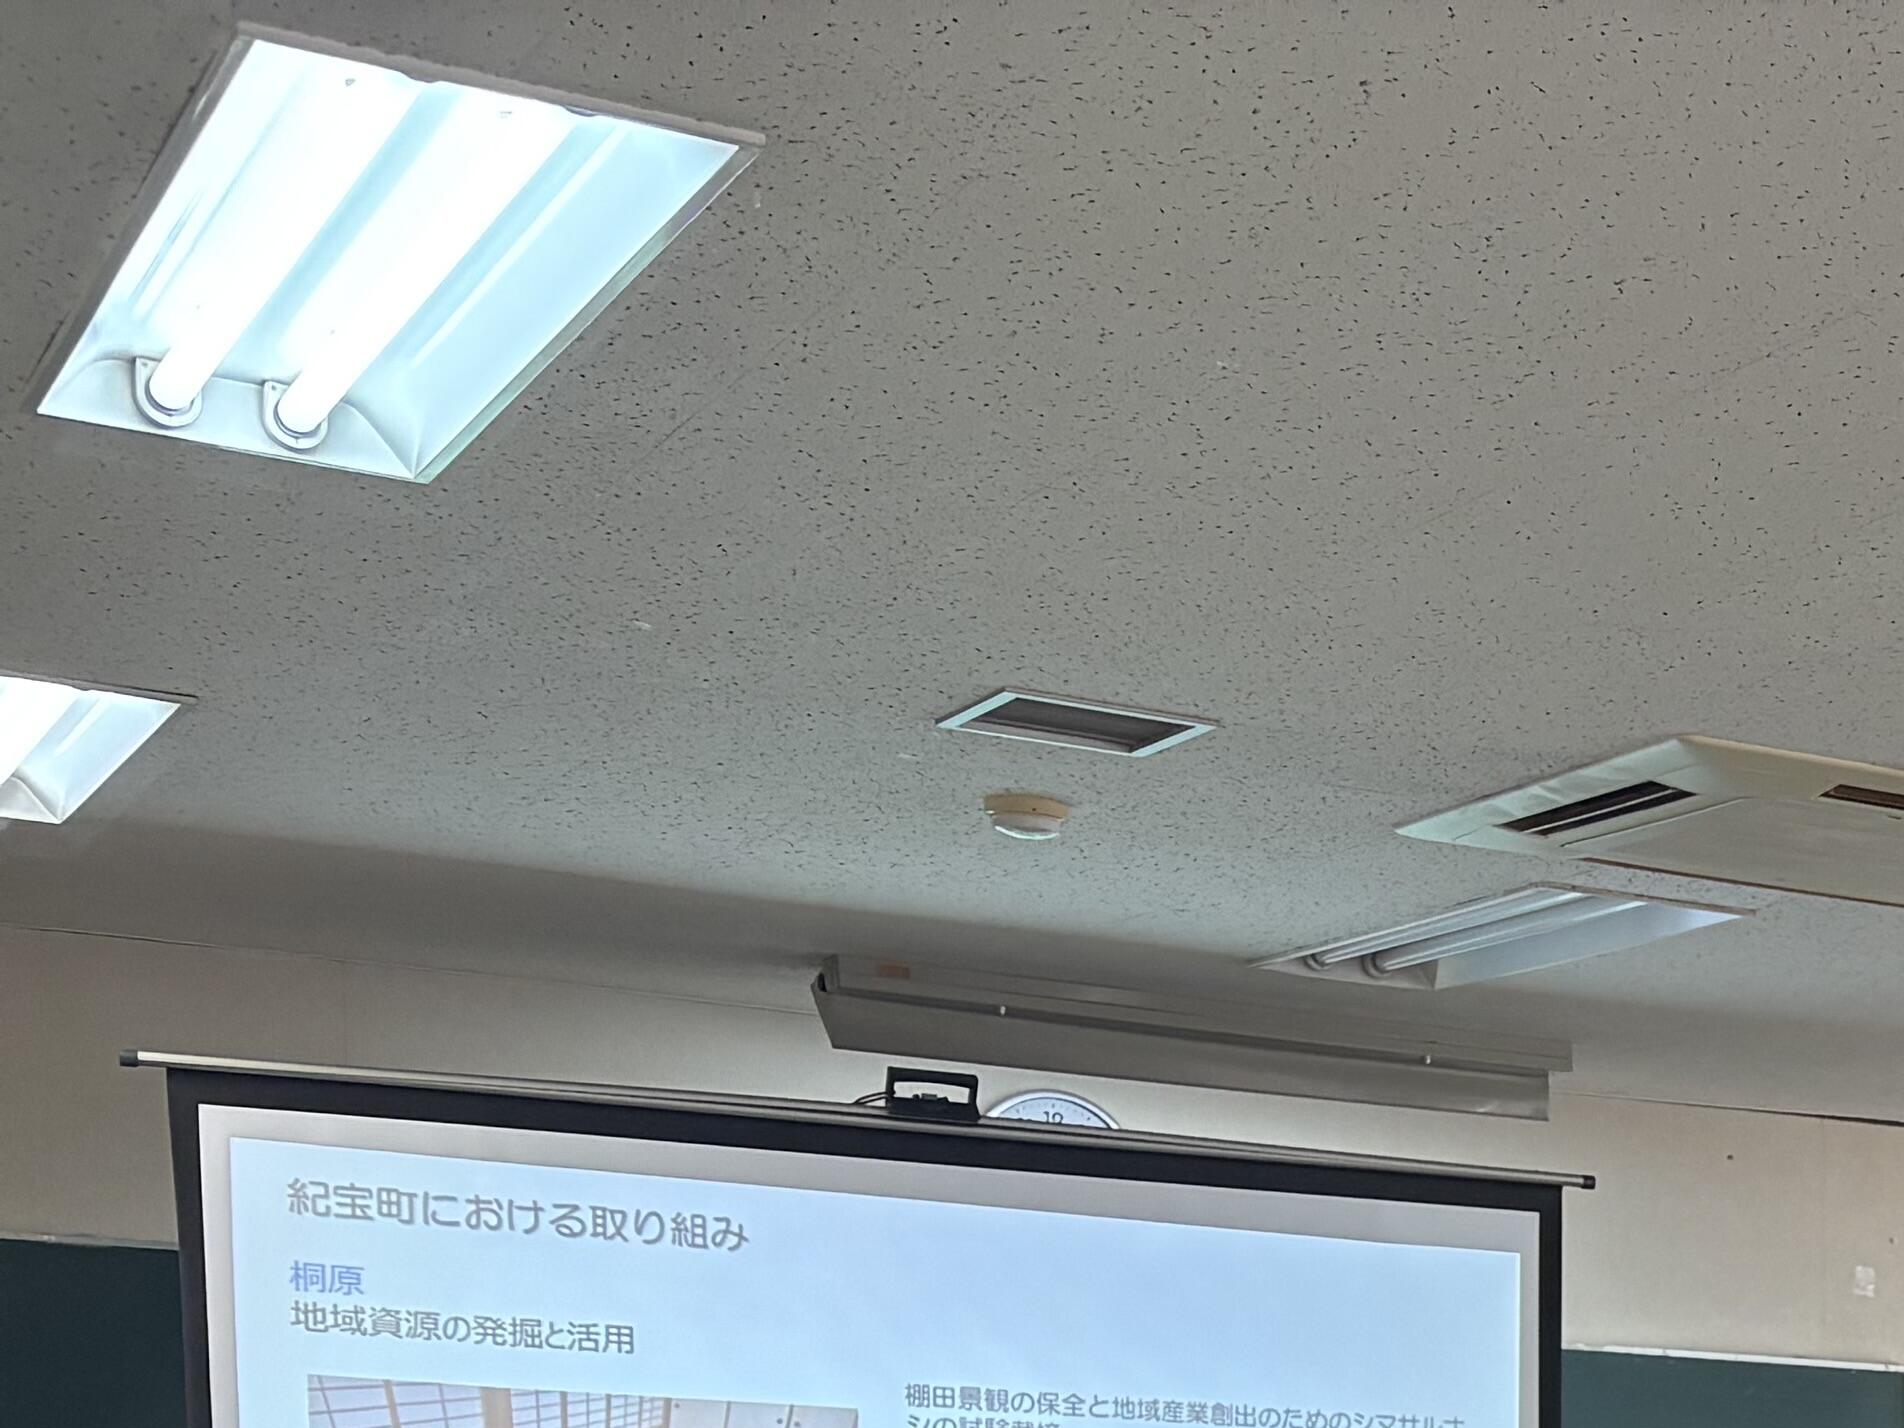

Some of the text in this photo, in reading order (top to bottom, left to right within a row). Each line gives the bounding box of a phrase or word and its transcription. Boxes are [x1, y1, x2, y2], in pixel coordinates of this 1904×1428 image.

[286, 1176, 750, 1253] 紀宝町における取り組み
[288, 1260, 367, 1296] 桐原
[288, 1300, 637, 1355] 地域資源の発掘と活用
